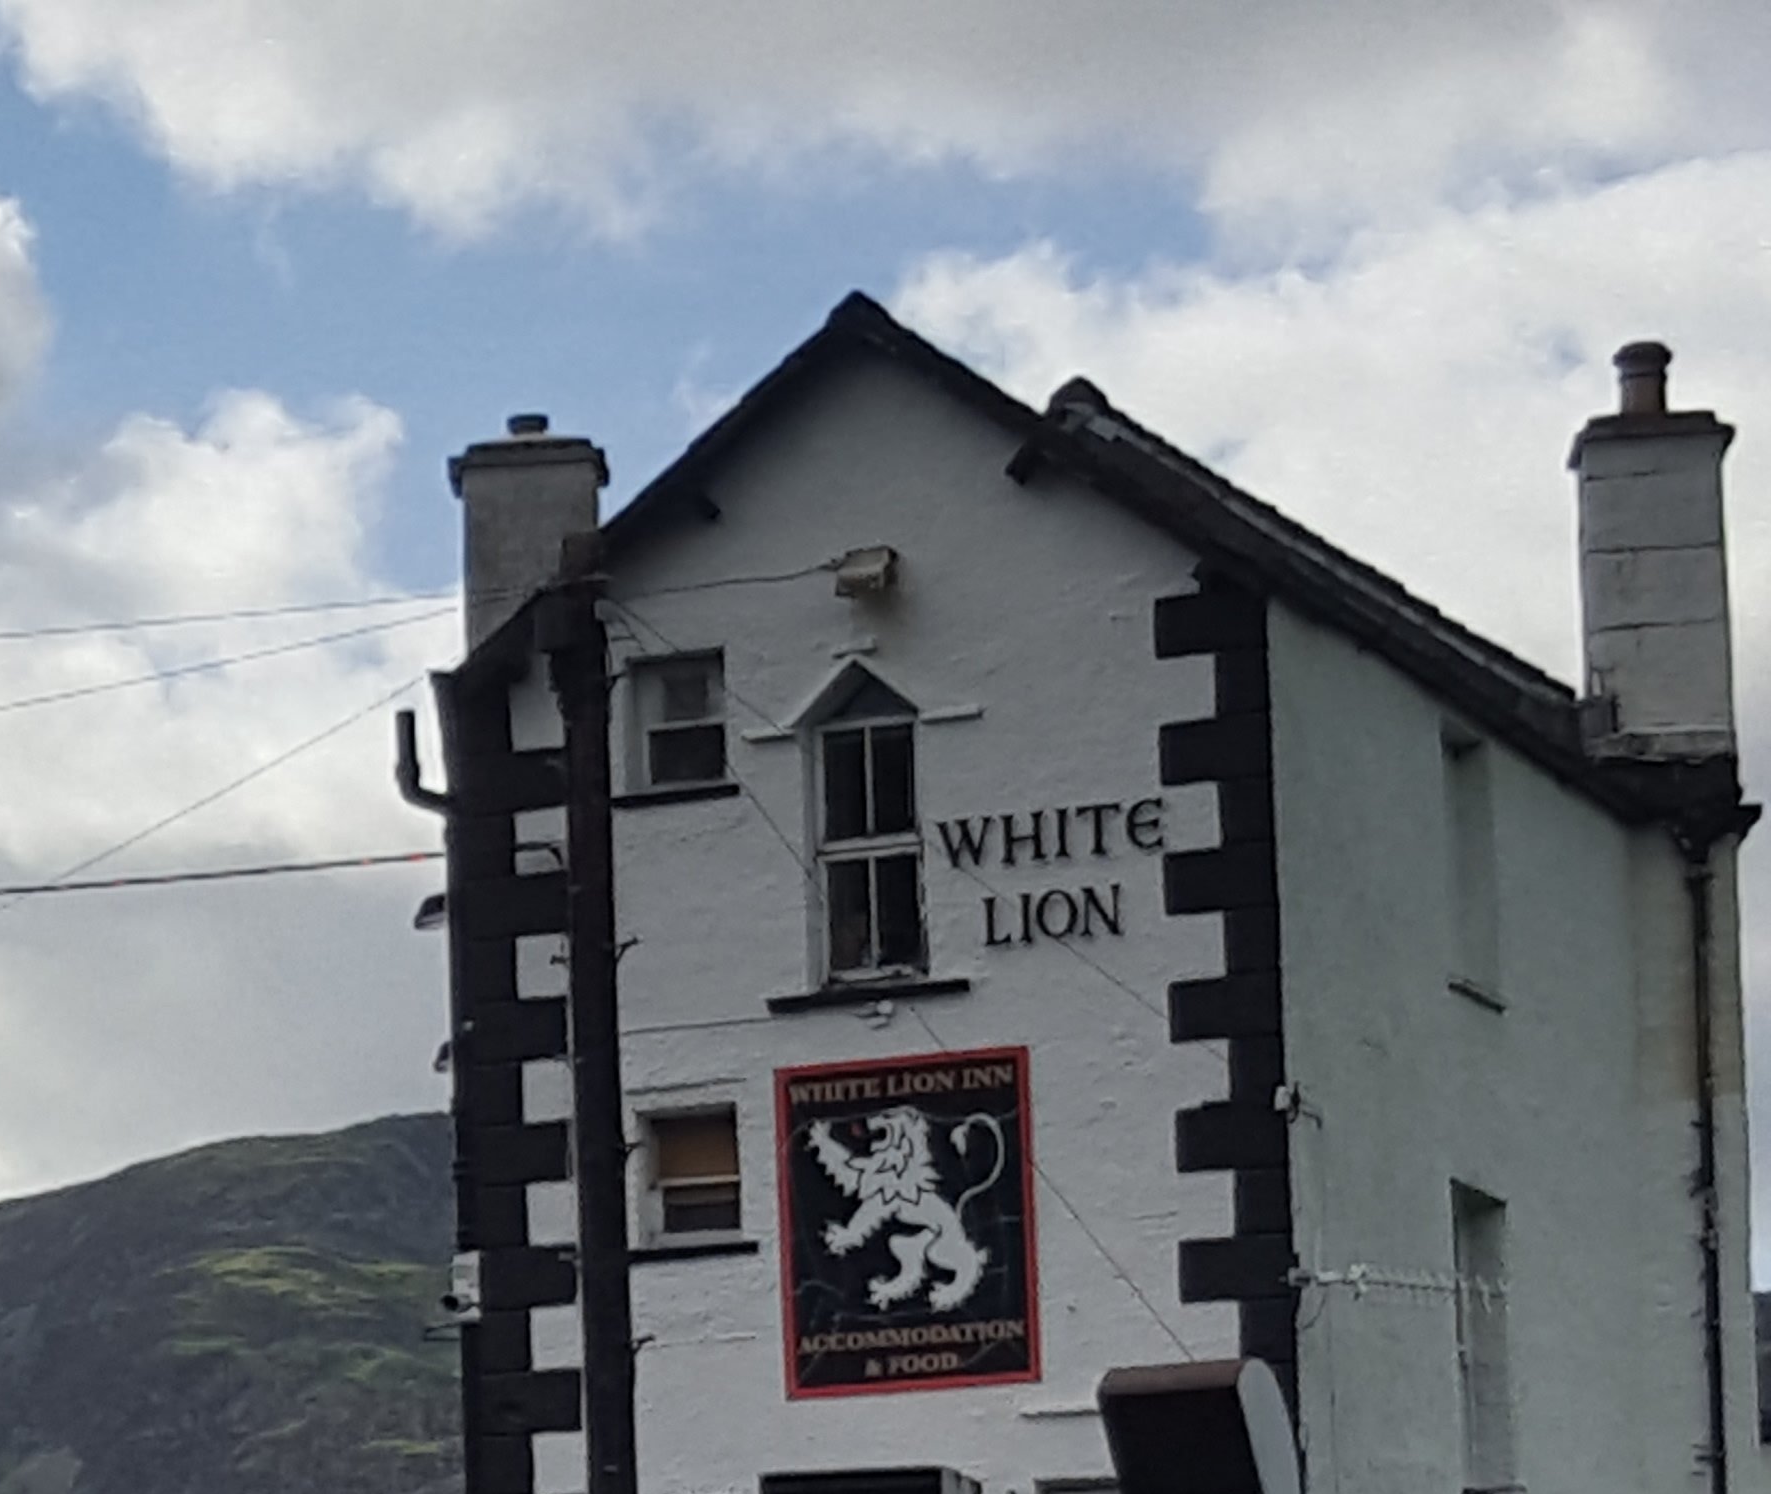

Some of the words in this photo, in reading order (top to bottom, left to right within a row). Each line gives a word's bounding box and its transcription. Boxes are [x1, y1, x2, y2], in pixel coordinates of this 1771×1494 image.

[936, 797, 1164, 869] WHITE
[982, 883, 1123, 947] LION
[789, 1079, 881, 1103] WHITE
[887, 1071, 955, 1096] LION
[962, 1065, 1014, 1089] INN
[798, 1320, 1025, 1353] ACCOMMODATION
[887, 1353, 957, 1375] FOOD
